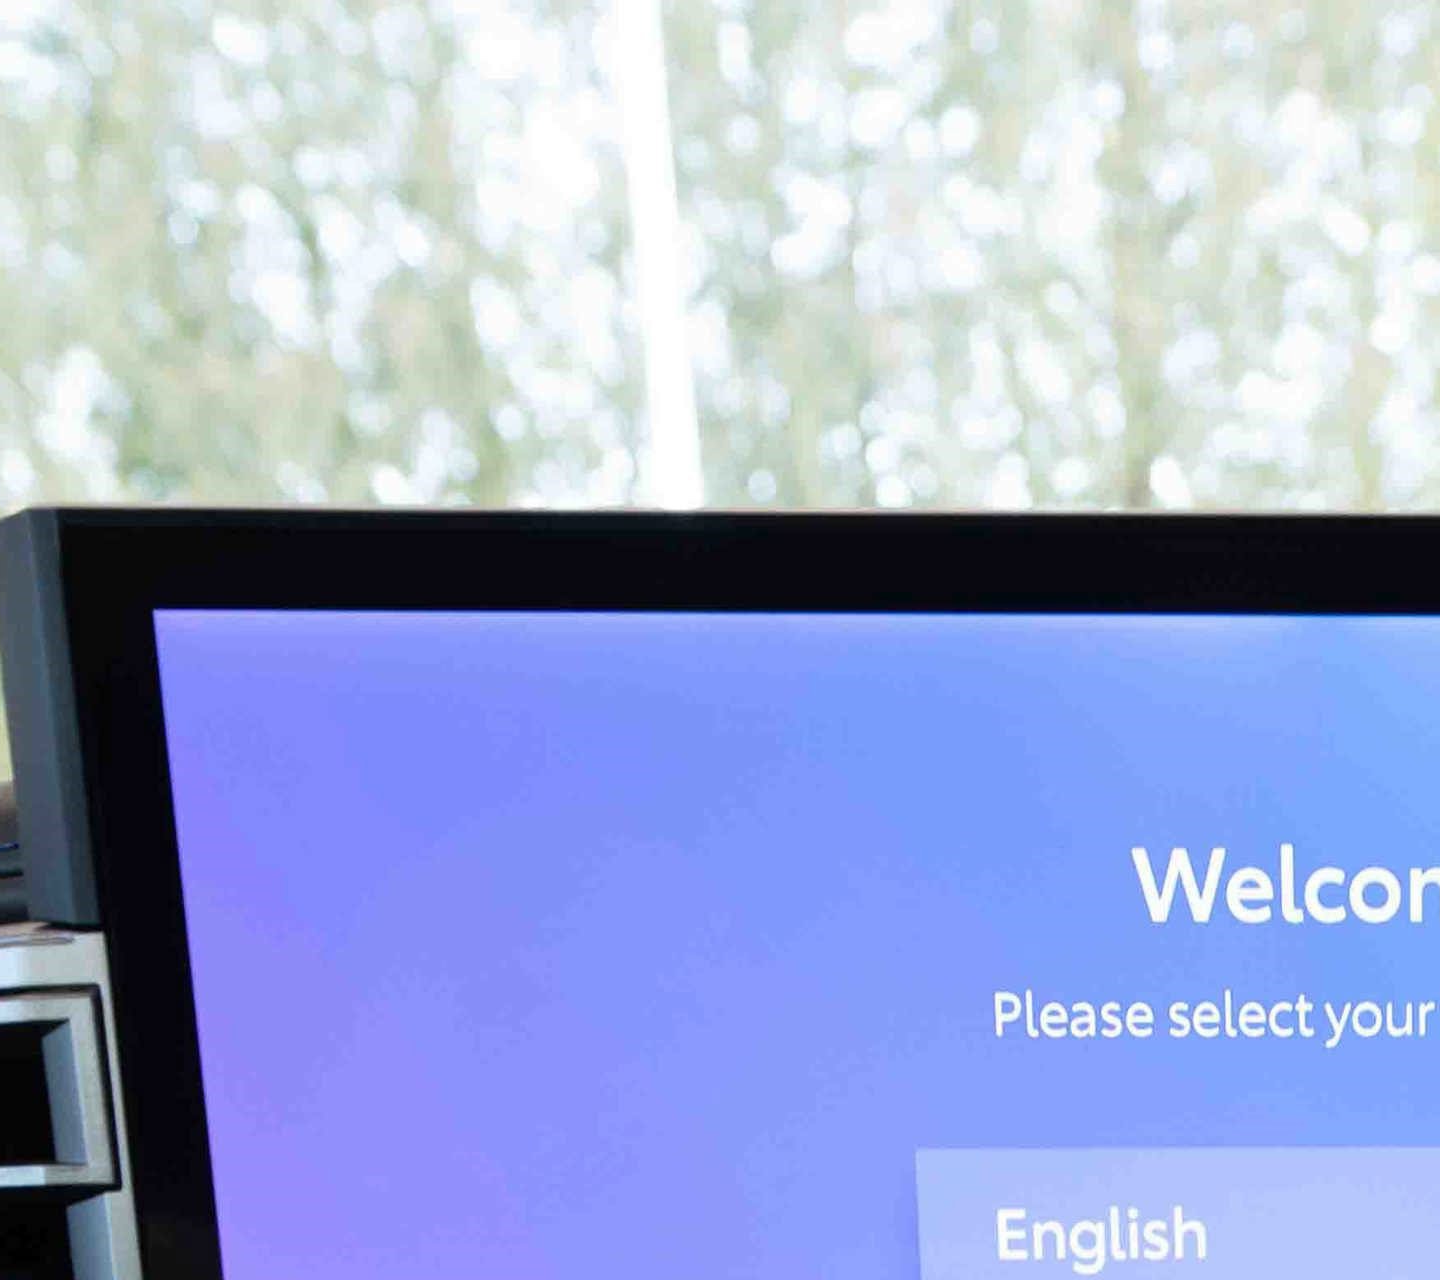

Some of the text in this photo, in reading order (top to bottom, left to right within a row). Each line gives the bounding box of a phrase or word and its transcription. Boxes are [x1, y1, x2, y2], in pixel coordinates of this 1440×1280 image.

[993, 991, 1155, 1040] Please
[1168, 991, 1313, 1040] select
[1324, 1001, 1434, 1049] your
[996, 1206, 1208, 1275] English
